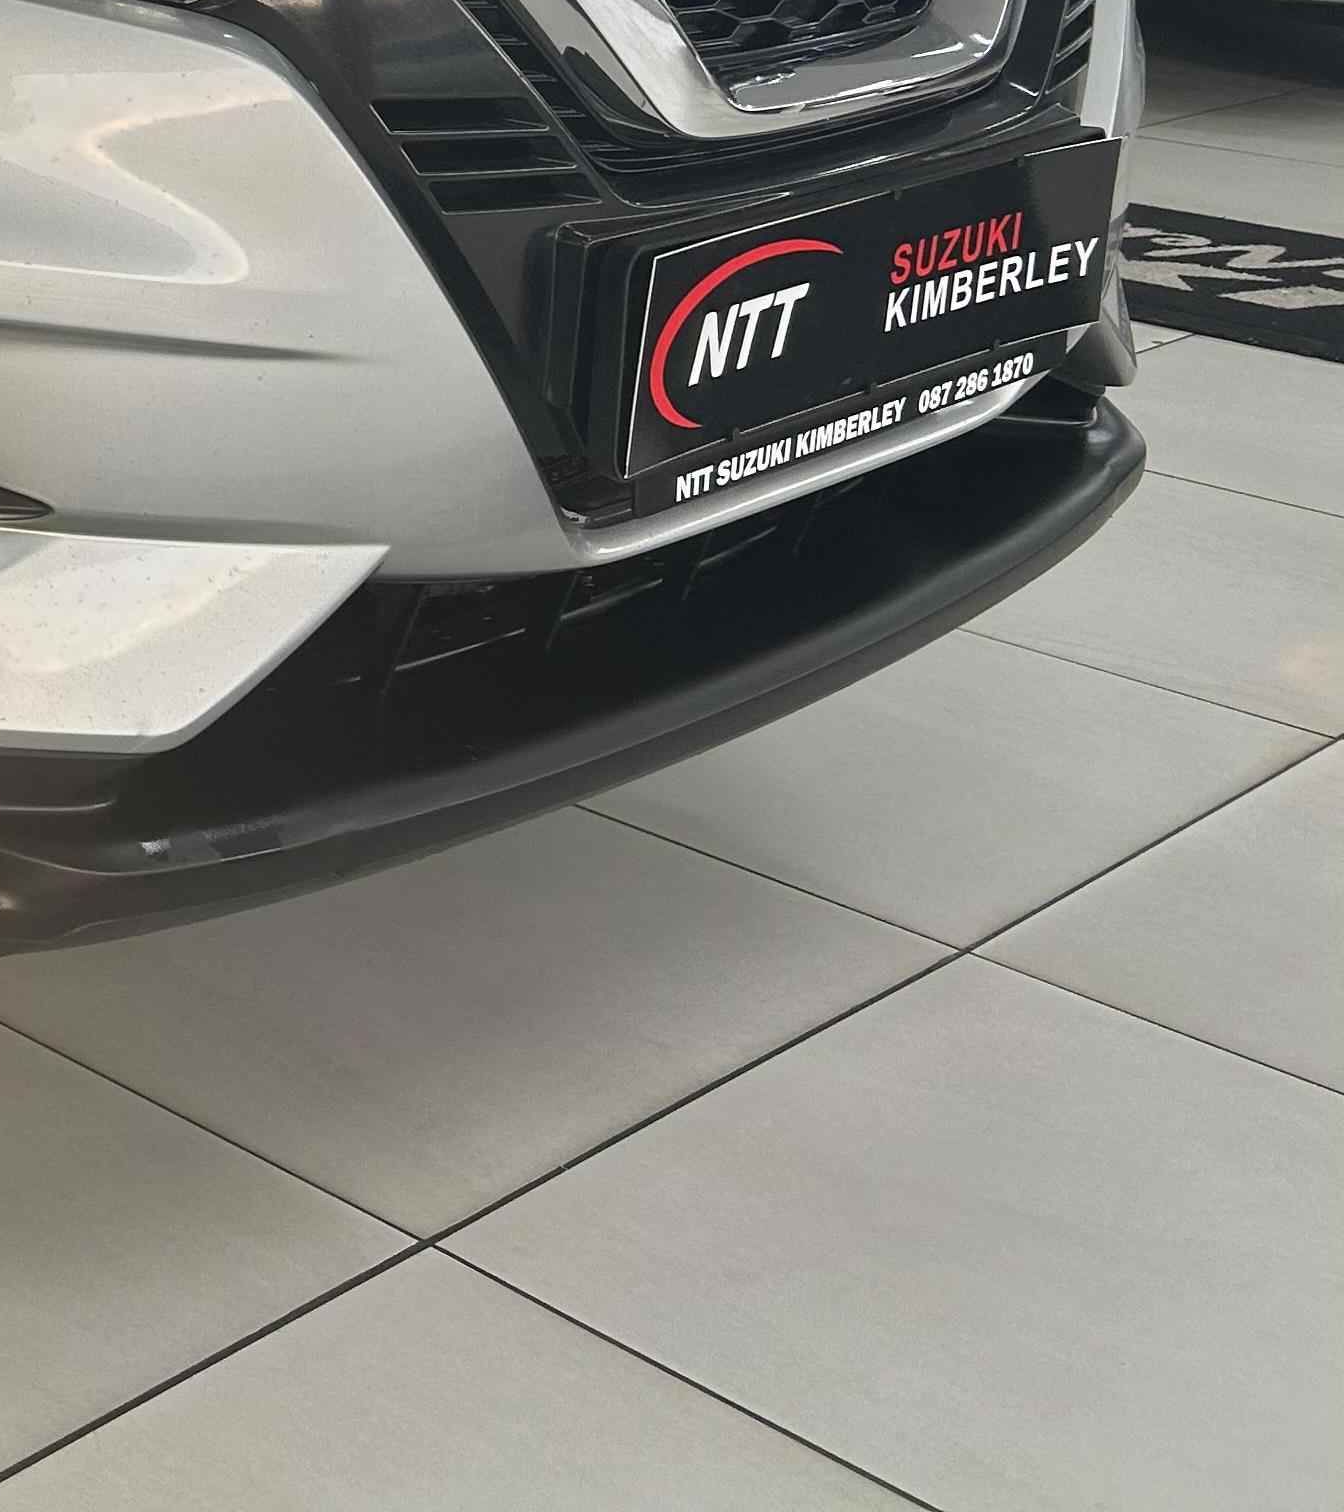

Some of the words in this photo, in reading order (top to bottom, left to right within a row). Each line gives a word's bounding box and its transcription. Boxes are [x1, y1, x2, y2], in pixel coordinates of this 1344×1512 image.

[883, 236, 1101, 333] KIMBERLEY
[890, 211, 1024, 286] SUZUKI
[688, 282, 810, 387] NTT
[675, 465, 715, 502] NTT
[715, 441, 792, 488] SUZUKI
[795, 397, 907, 459] KIMBERLEY
[918, 384, 954, 415] 087
[954, 368, 989, 402] 286
[991, 352, 1035, 386] 1870
